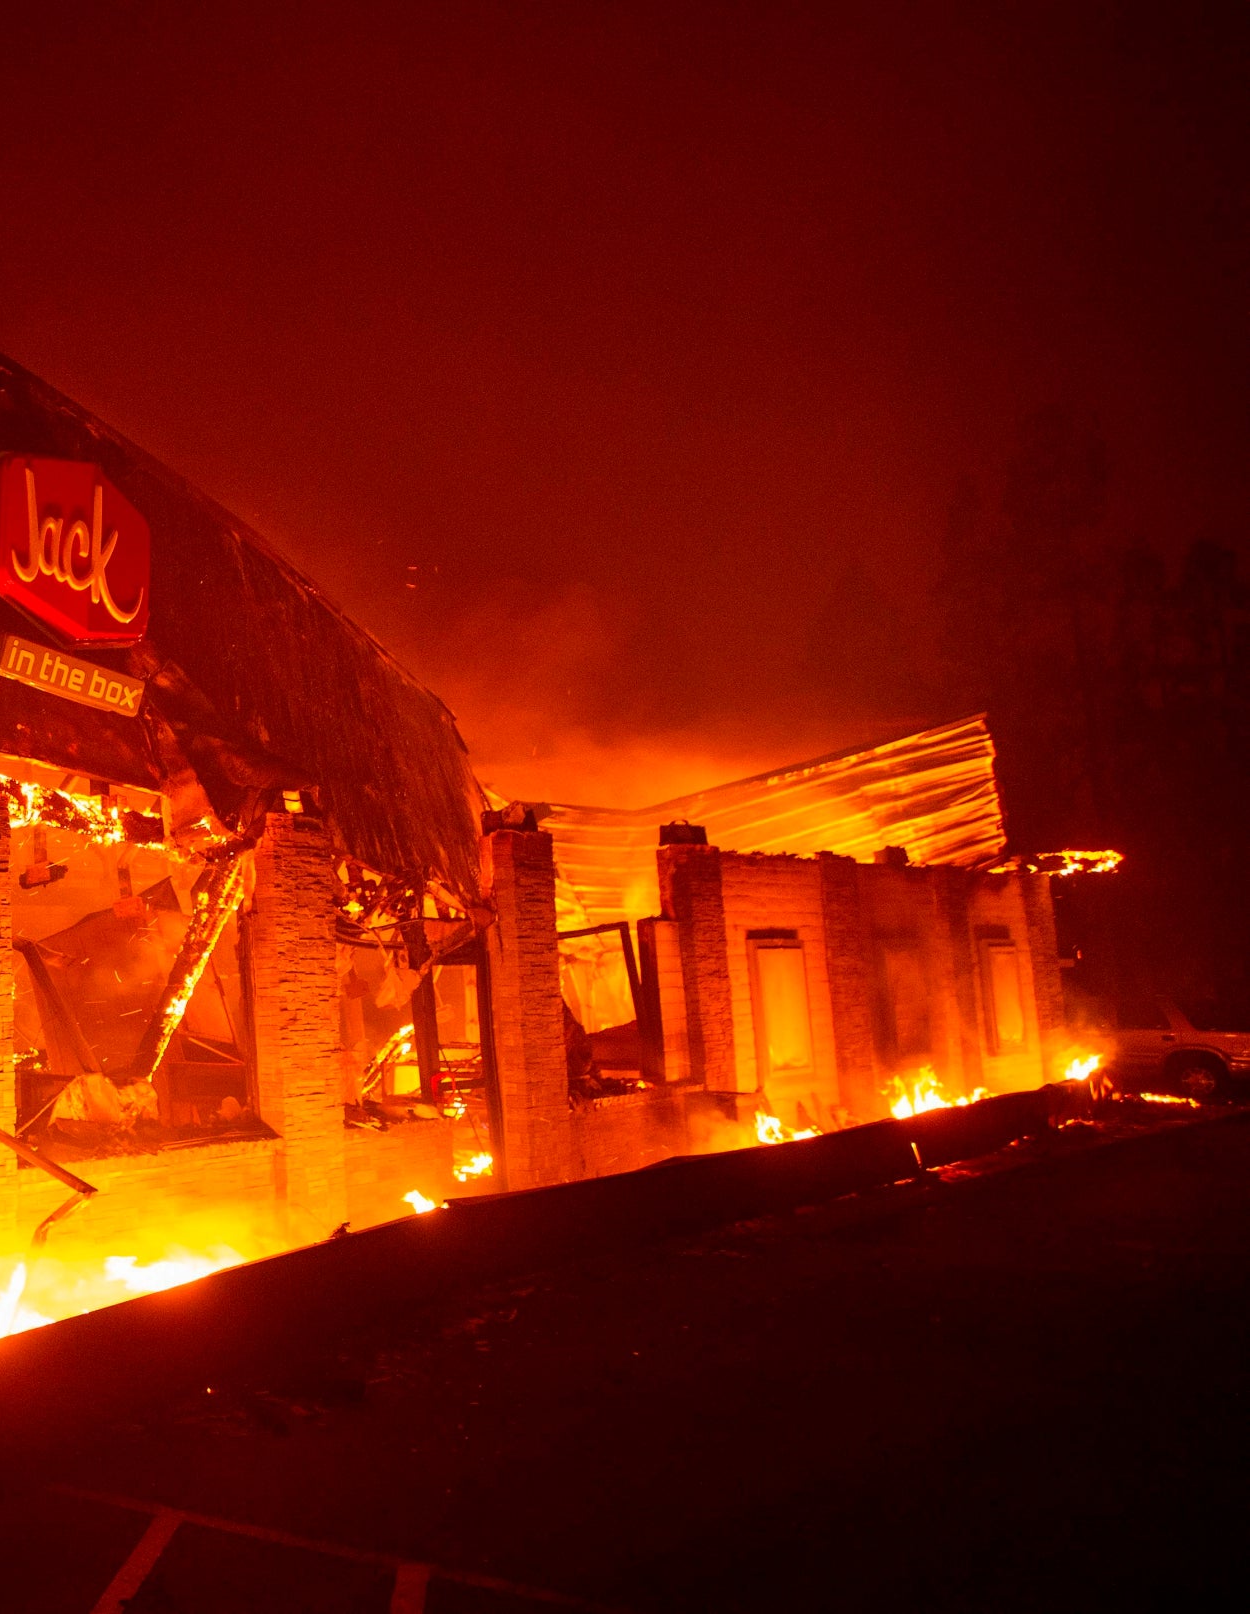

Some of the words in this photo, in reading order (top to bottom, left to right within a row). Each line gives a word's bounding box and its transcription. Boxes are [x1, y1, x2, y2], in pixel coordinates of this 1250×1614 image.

[12, 468, 144, 624] Jack
[7, 639, 36, 675] in
[39, 652, 86, 692] the
[88, 669, 140, 709] box
